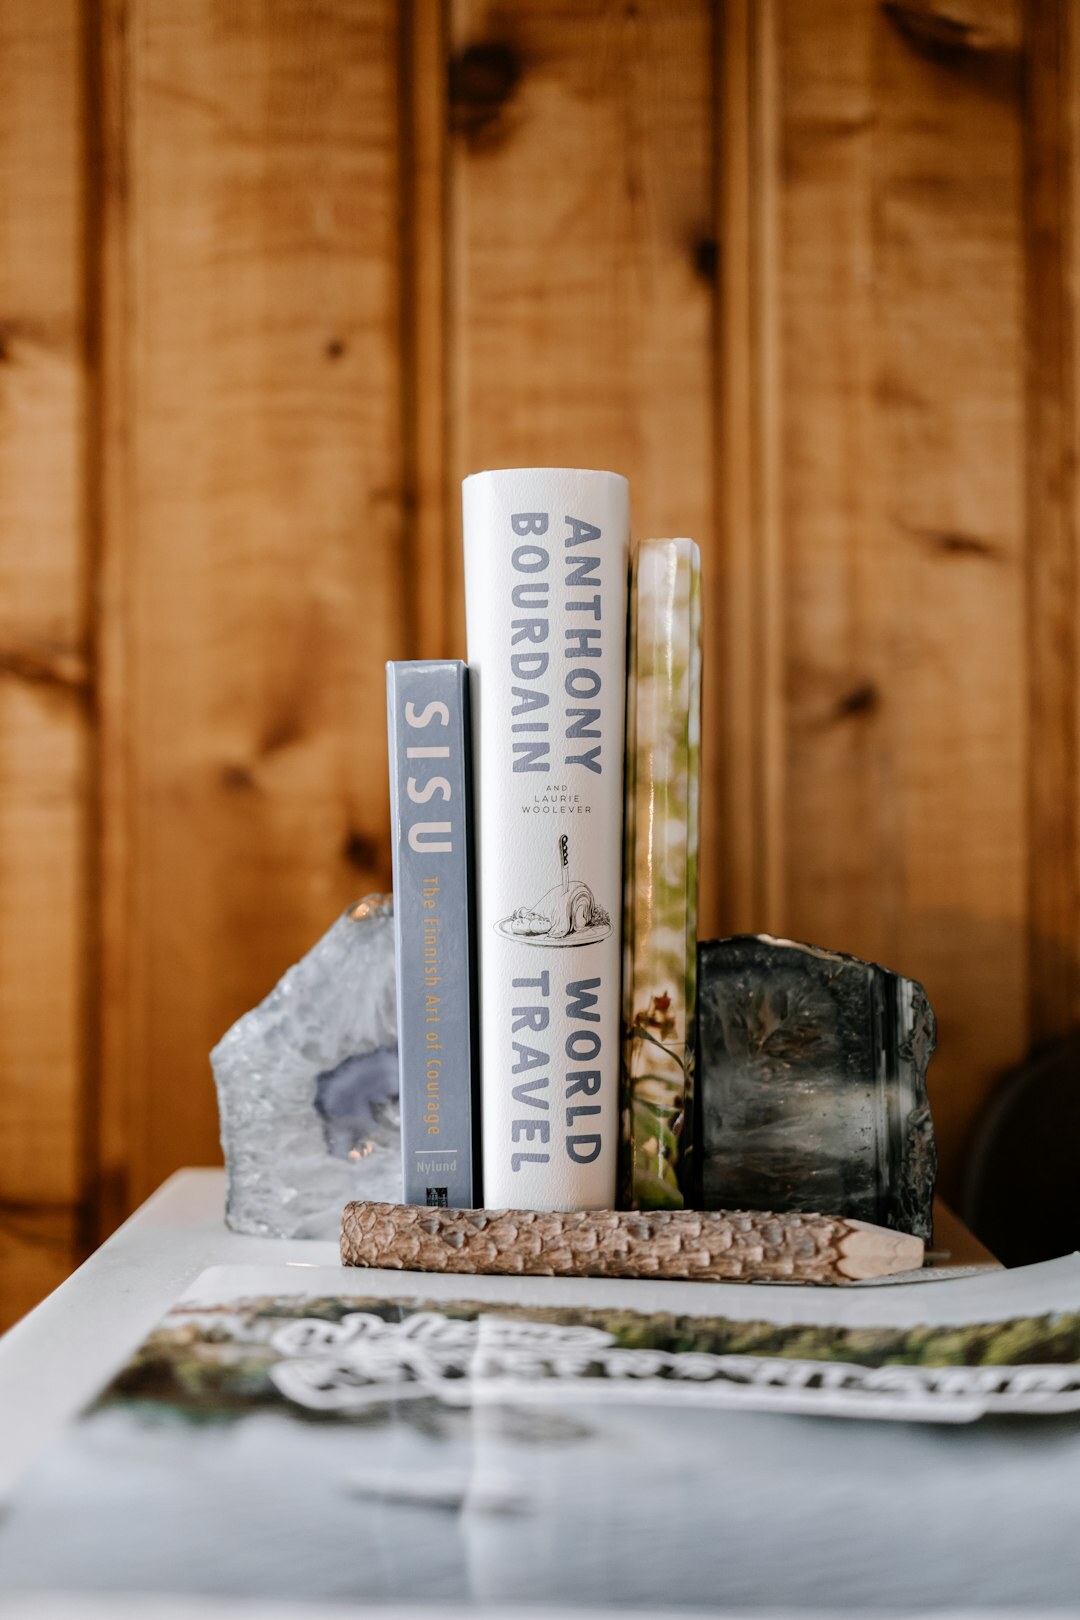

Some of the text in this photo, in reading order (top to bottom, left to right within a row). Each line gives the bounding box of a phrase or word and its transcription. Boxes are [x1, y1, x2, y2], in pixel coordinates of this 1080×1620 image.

[510, 512, 550, 773] BOURDAIN
[564, 515, 602, 774] ANTHONY
[405, 701, 453, 853] SISU
[521, 805, 592, 814] WOOLEVER
[533, 794, 581, 803] LAURIE
[545, 784, 568, 792] AND
[422, 876, 442, 1136] The Finnish Art of Courage
[511, 970, 550, 1172] TRAVEL
[565, 976, 602, 1164] WORLD
[416, 1160, 457, 1175] Nylund
